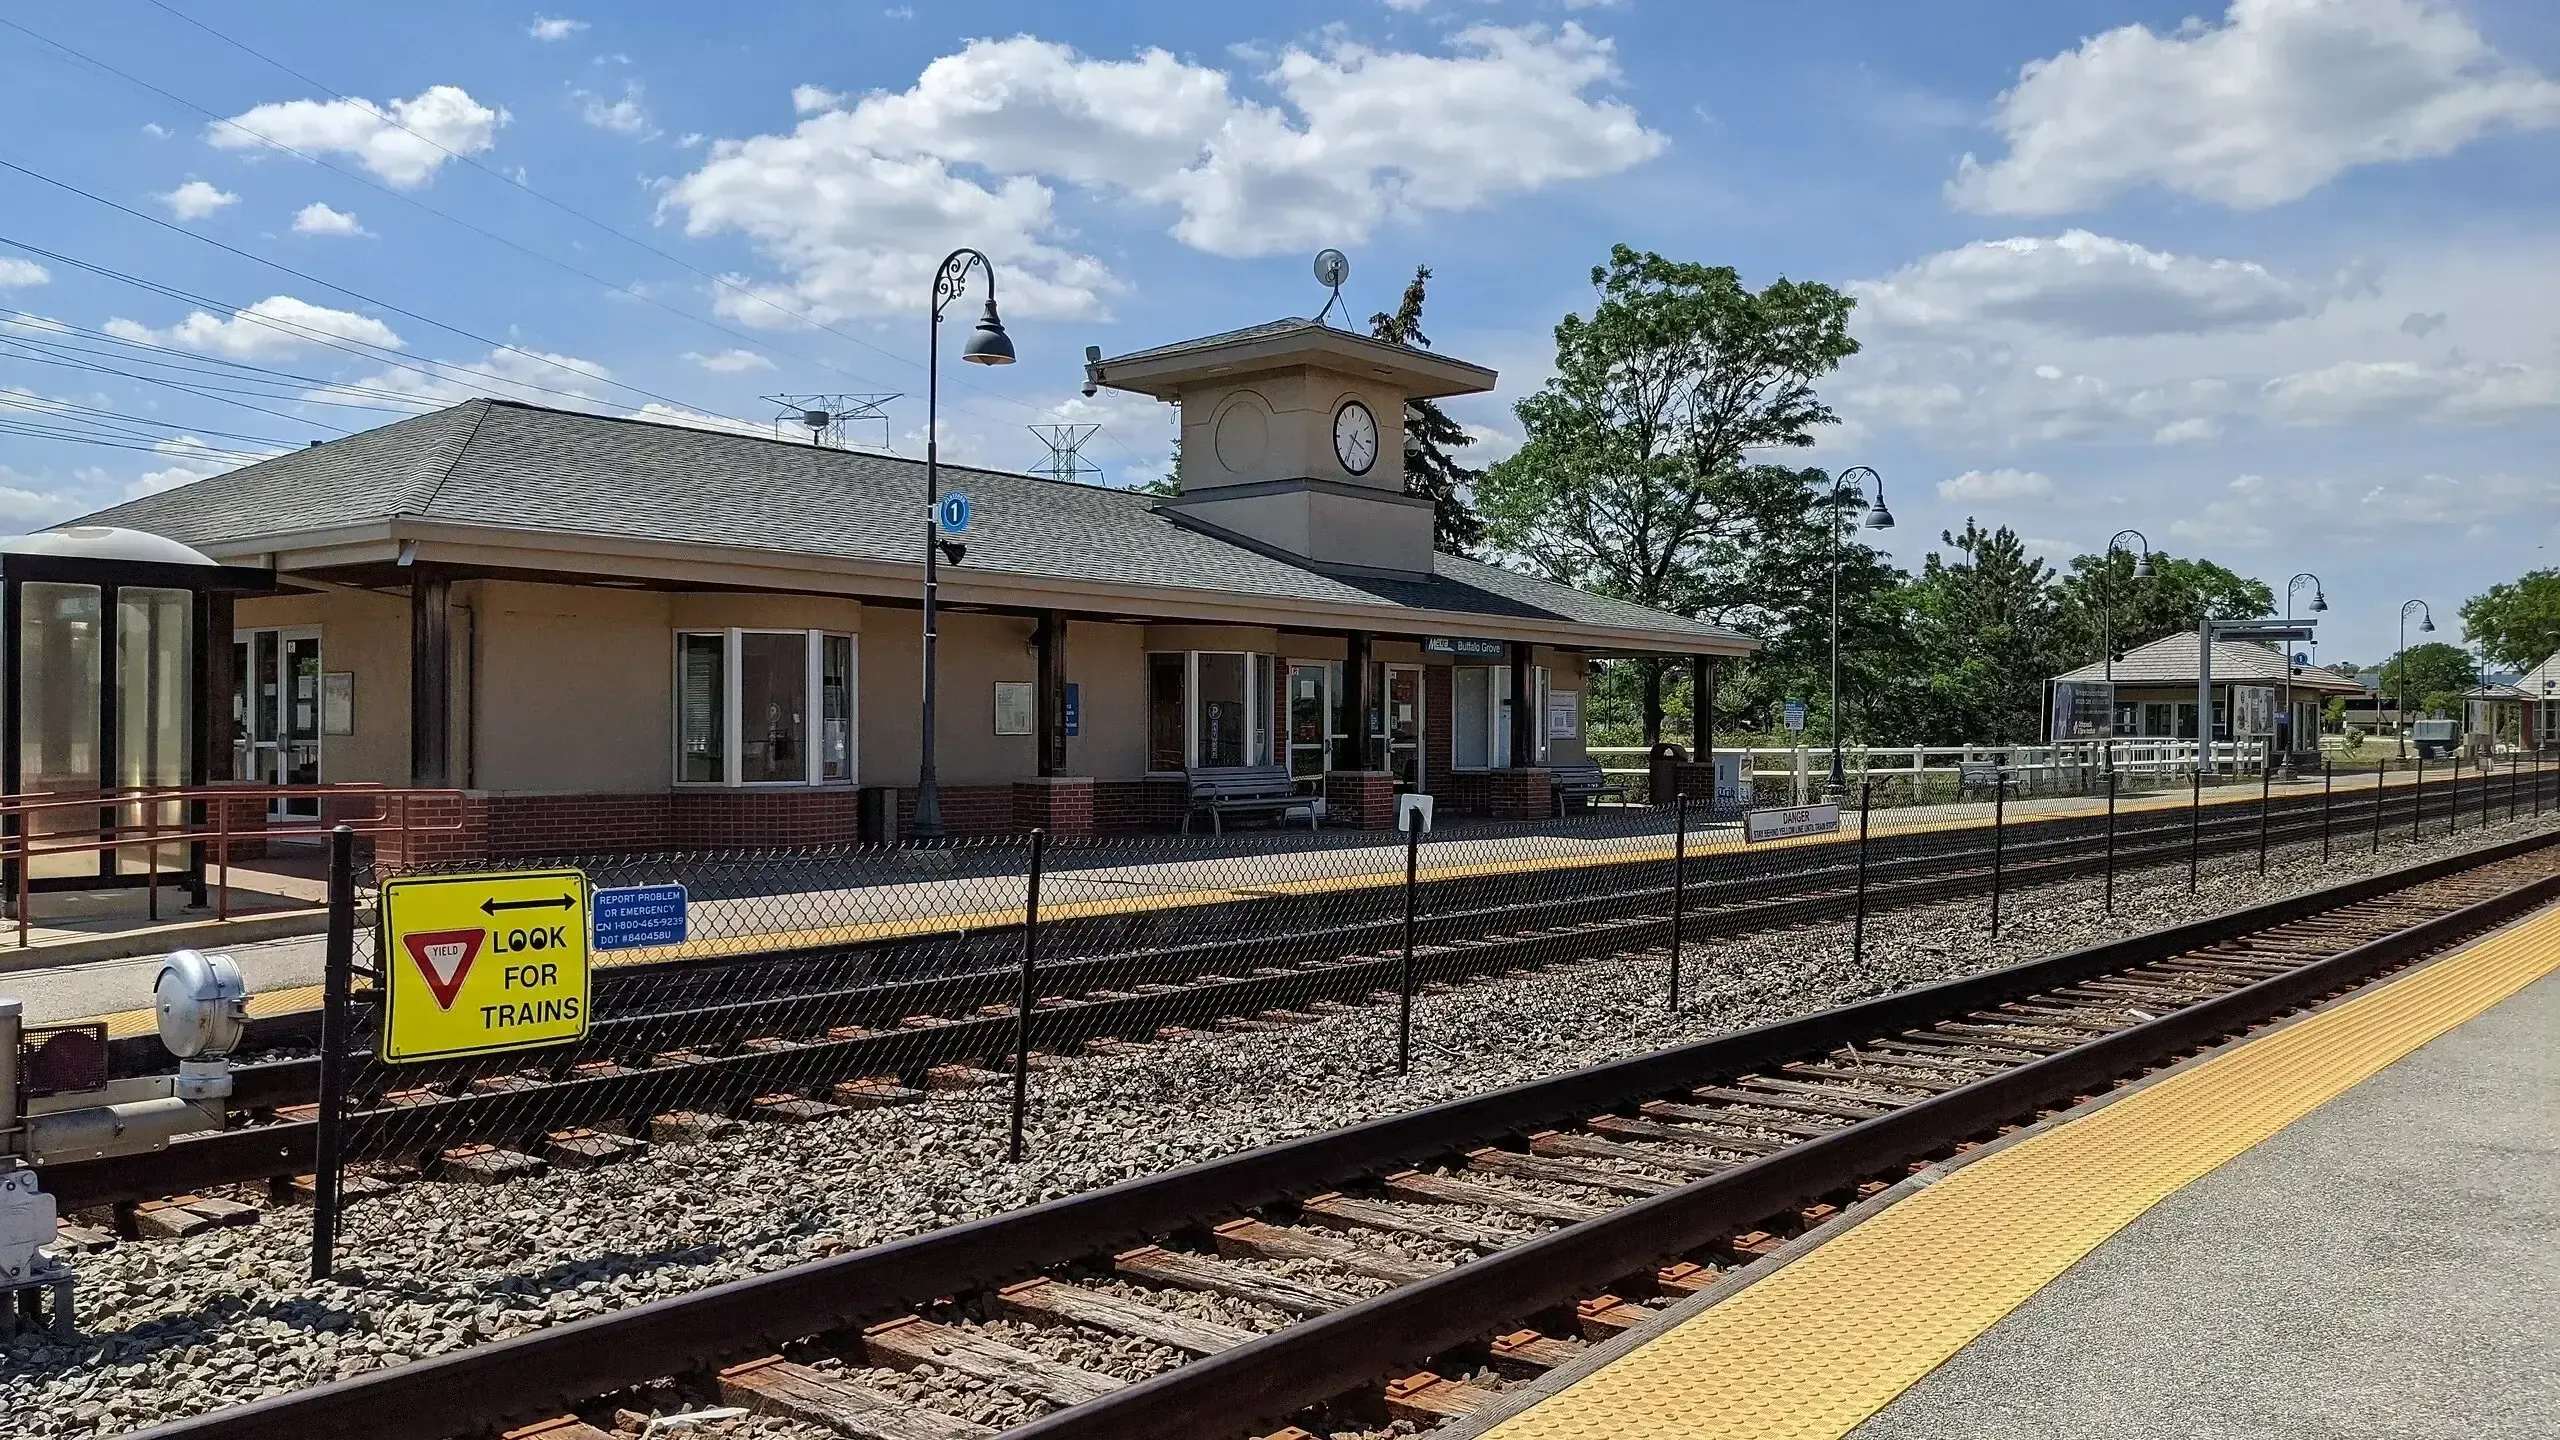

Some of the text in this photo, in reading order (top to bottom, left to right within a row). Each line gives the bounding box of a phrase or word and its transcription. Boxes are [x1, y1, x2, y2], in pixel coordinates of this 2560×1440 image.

[950, 502, 958, 522] 1
[1428, 637, 1501, 653] Metra Buffalo Grove
[1783, 810, 1810, 825] DANGER
[1753, 821, 1838, 839] STAY BEHIND YELLOW LINE UNTIL TRAIN STOPS
[600, 891, 680, 904] REPORT PROBLEM
[604, 905, 675, 917] OR EMERGENCY
[596, 917, 684, 931] CN 1-800-465-9239
[492, 925, 567, 954] LOOK
[601, 935, 619, 944] DOT
[432, 946, 458, 957] YIELD
[504, 963, 558, 990] FOR
[480, 997, 579, 1029] TRAINS
